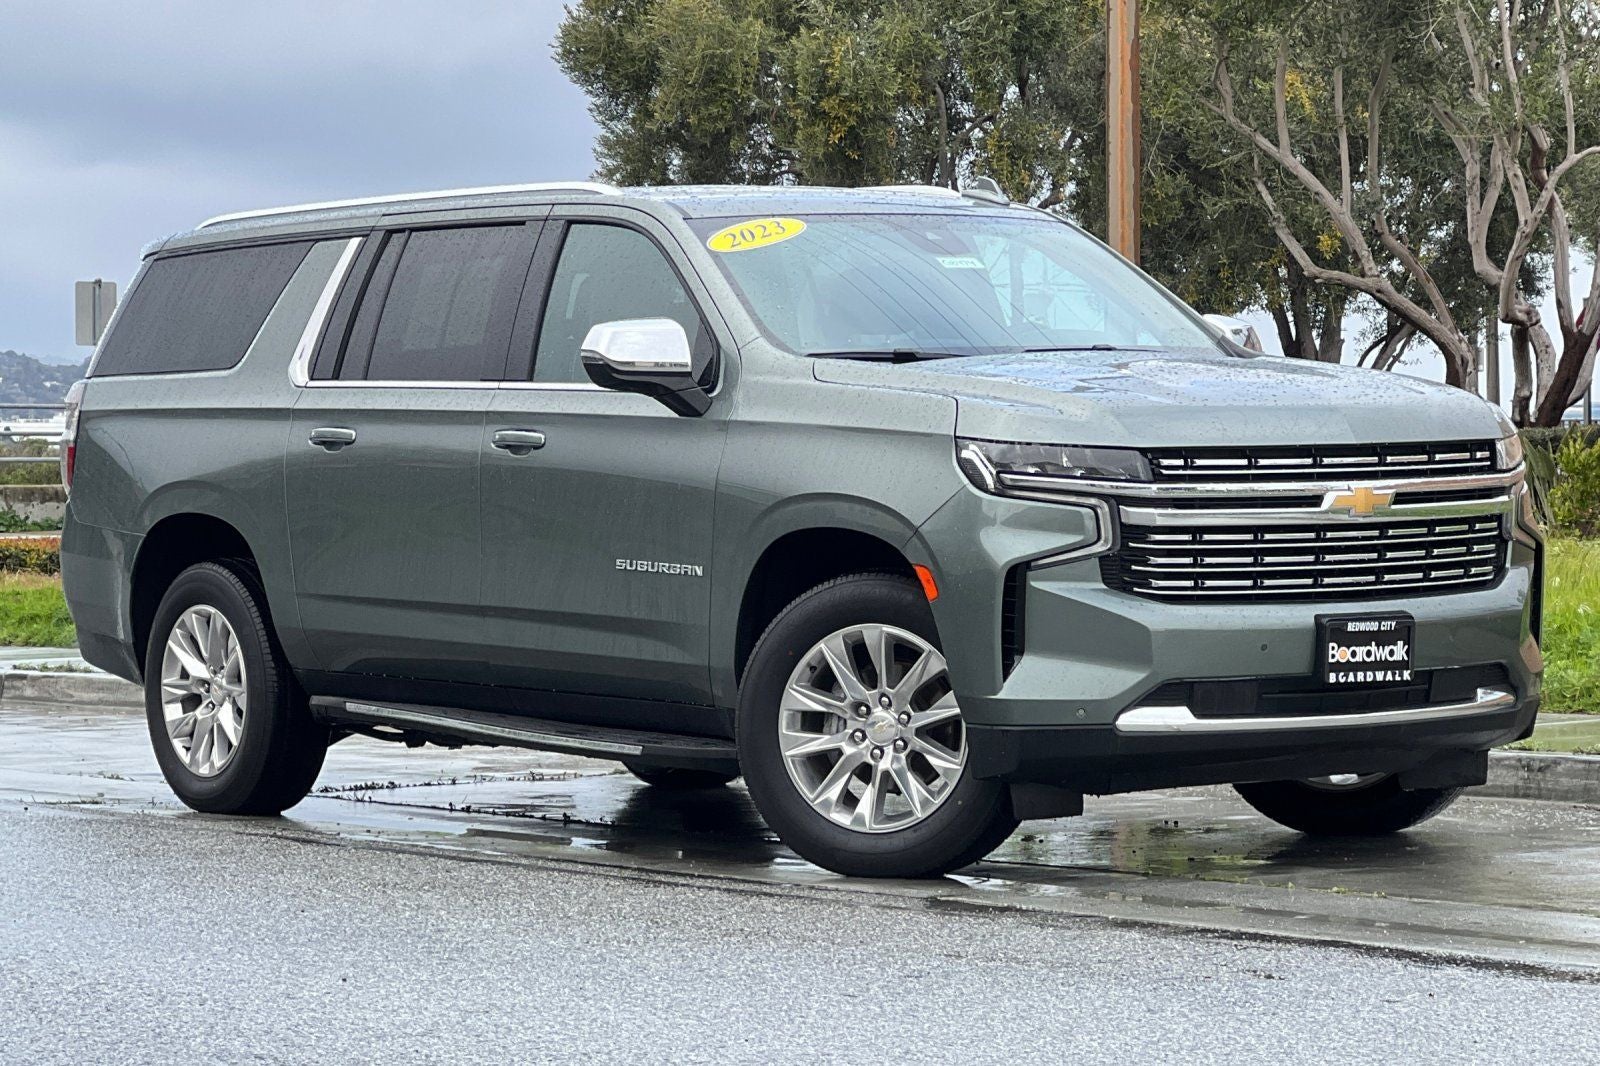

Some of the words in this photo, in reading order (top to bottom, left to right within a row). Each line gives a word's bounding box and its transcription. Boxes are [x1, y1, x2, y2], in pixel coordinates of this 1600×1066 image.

[723, 220, 787, 249] 2023
[615, 558, 704, 577] SUBURBAN
[1347, 621, 1379, 632] REDWOOD
[1380, 620, 1397, 631] CITY
[1328, 640, 1408, 663] Boardwalk
[1329, 669, 1411, 684] BOARDWALK
